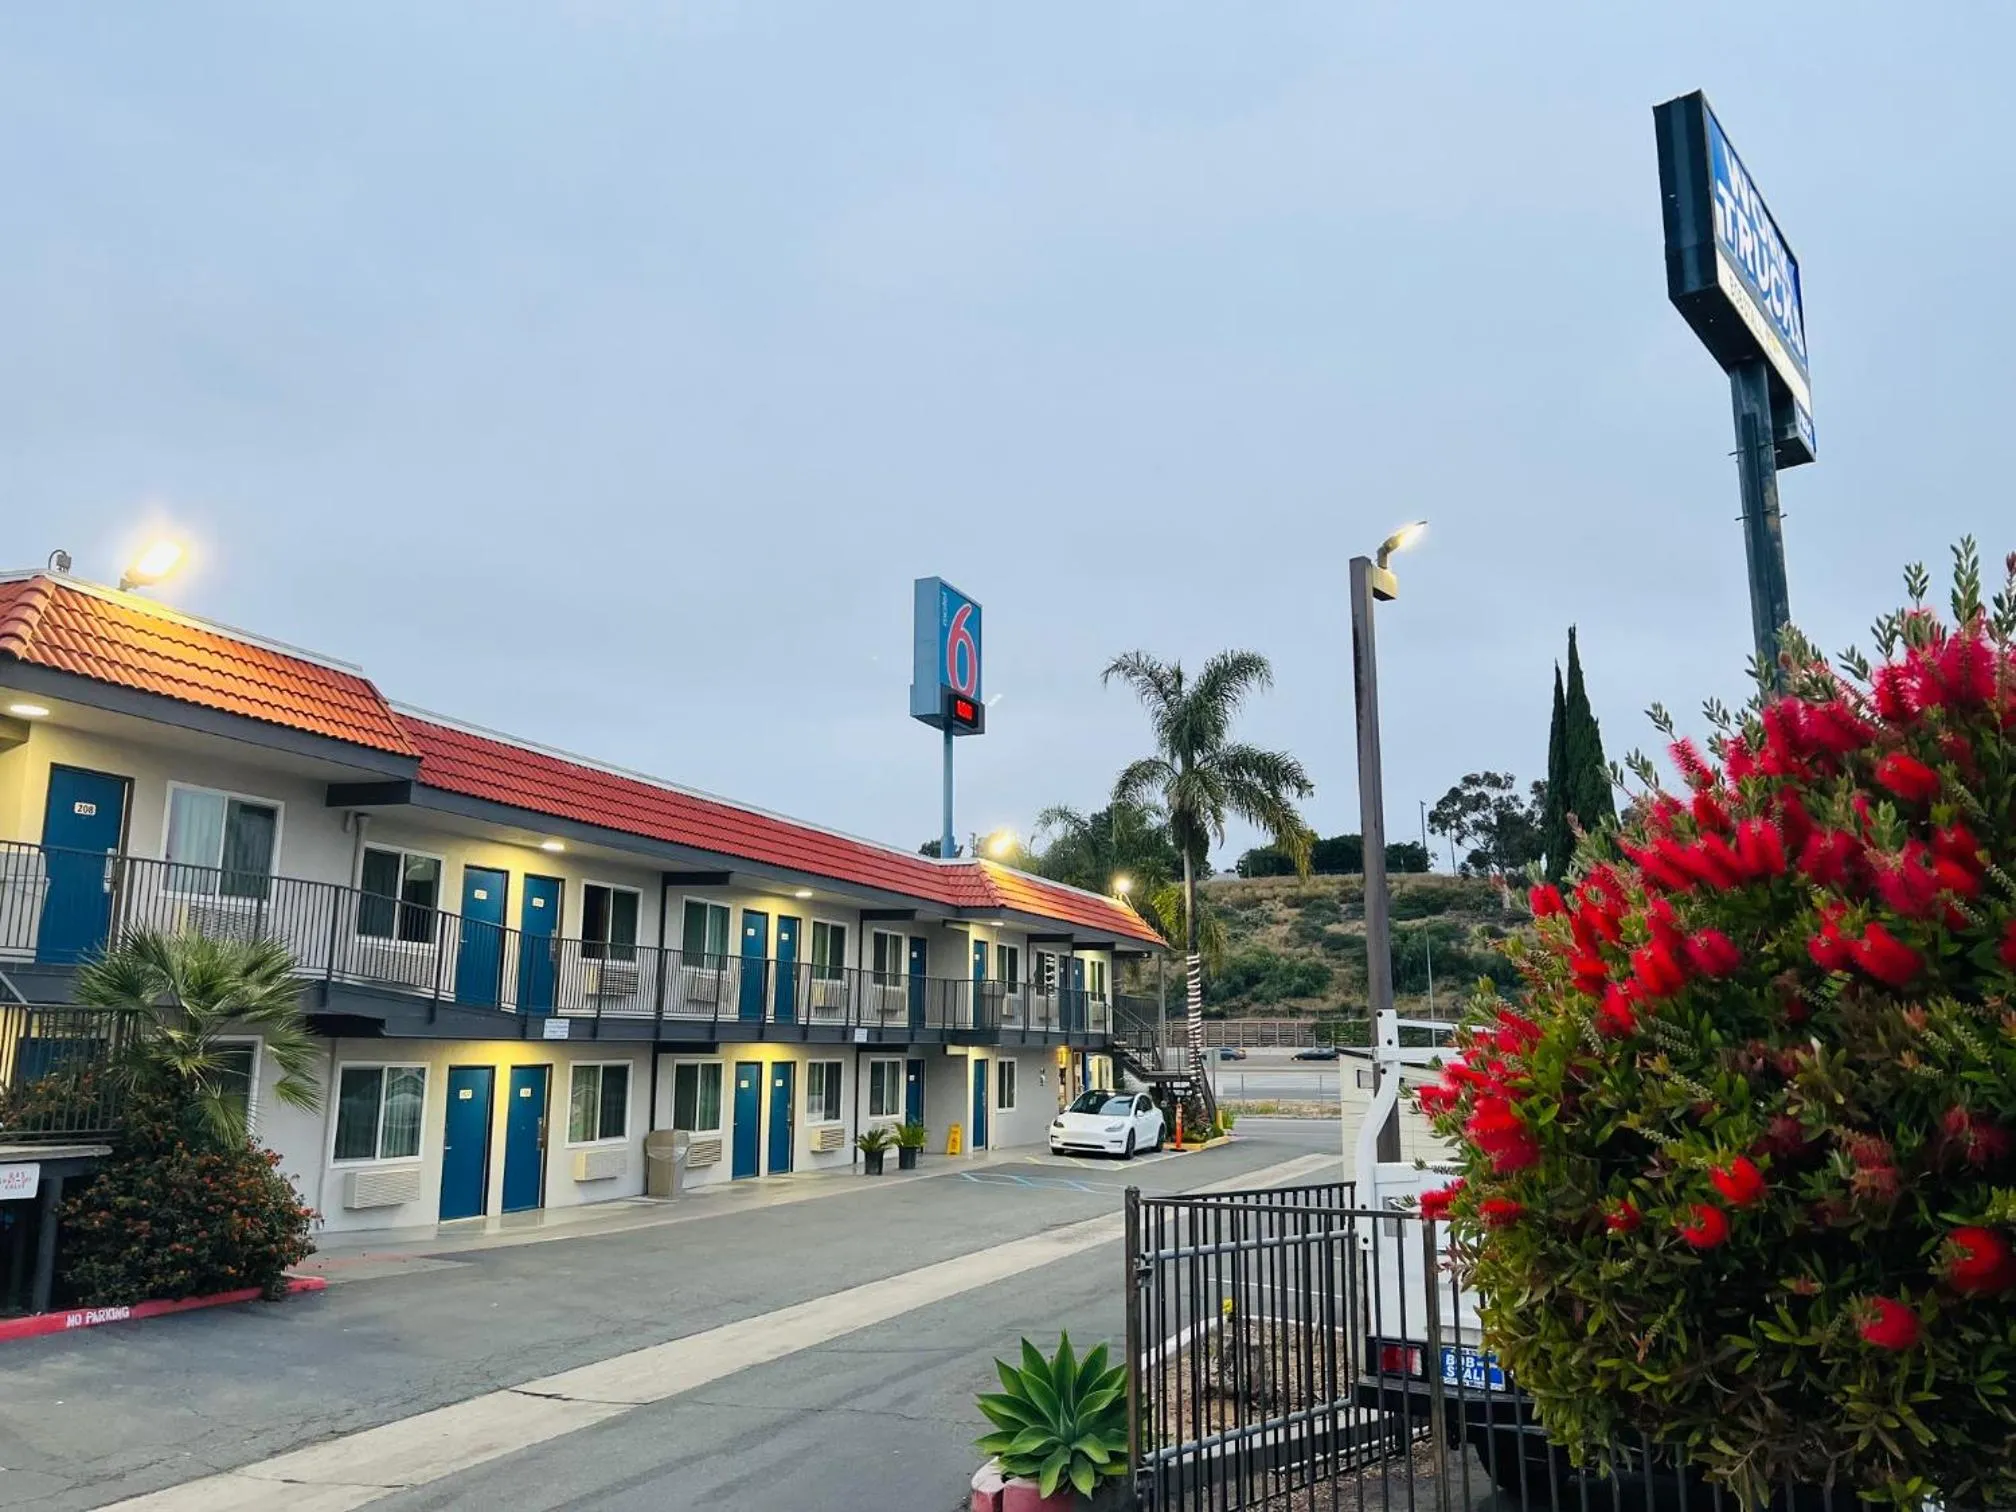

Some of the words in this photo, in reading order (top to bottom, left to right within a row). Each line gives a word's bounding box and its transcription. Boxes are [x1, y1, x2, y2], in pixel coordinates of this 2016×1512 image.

[1721, 139, 1792, 292] WORK
[947, 603, 977, 698] 6
[66, 1313, 83, 1328] NO
[86, 1306, 130, 1324] PARKING
[1446, 1366, 1486, 1381] SAL
